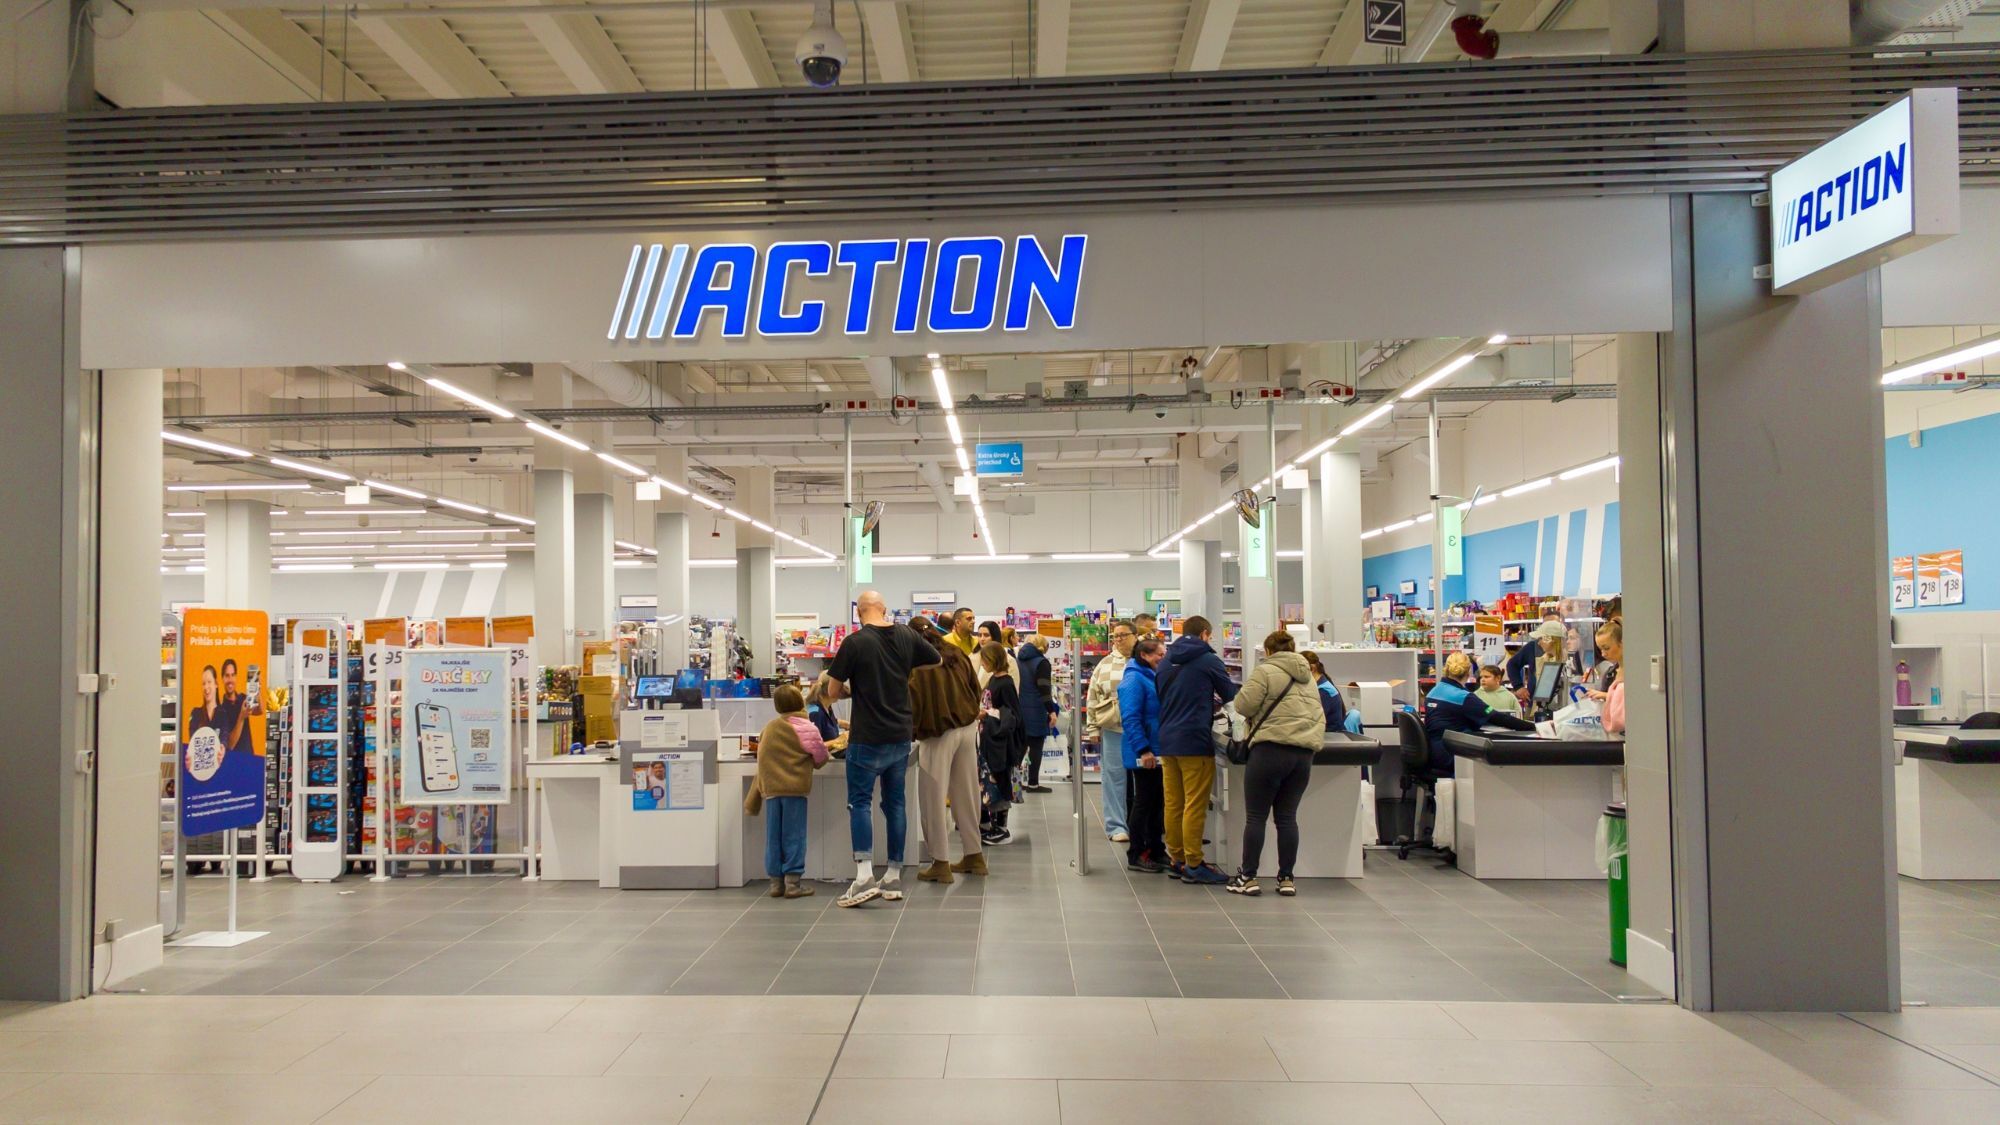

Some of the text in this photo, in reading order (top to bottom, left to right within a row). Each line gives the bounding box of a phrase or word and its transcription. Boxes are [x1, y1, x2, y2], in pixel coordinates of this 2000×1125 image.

[1794, 142, 1907, 243] ACTION
[671, 234, 1088, 338] ACTION
[422, 666, 493, 684] DARČEKY
